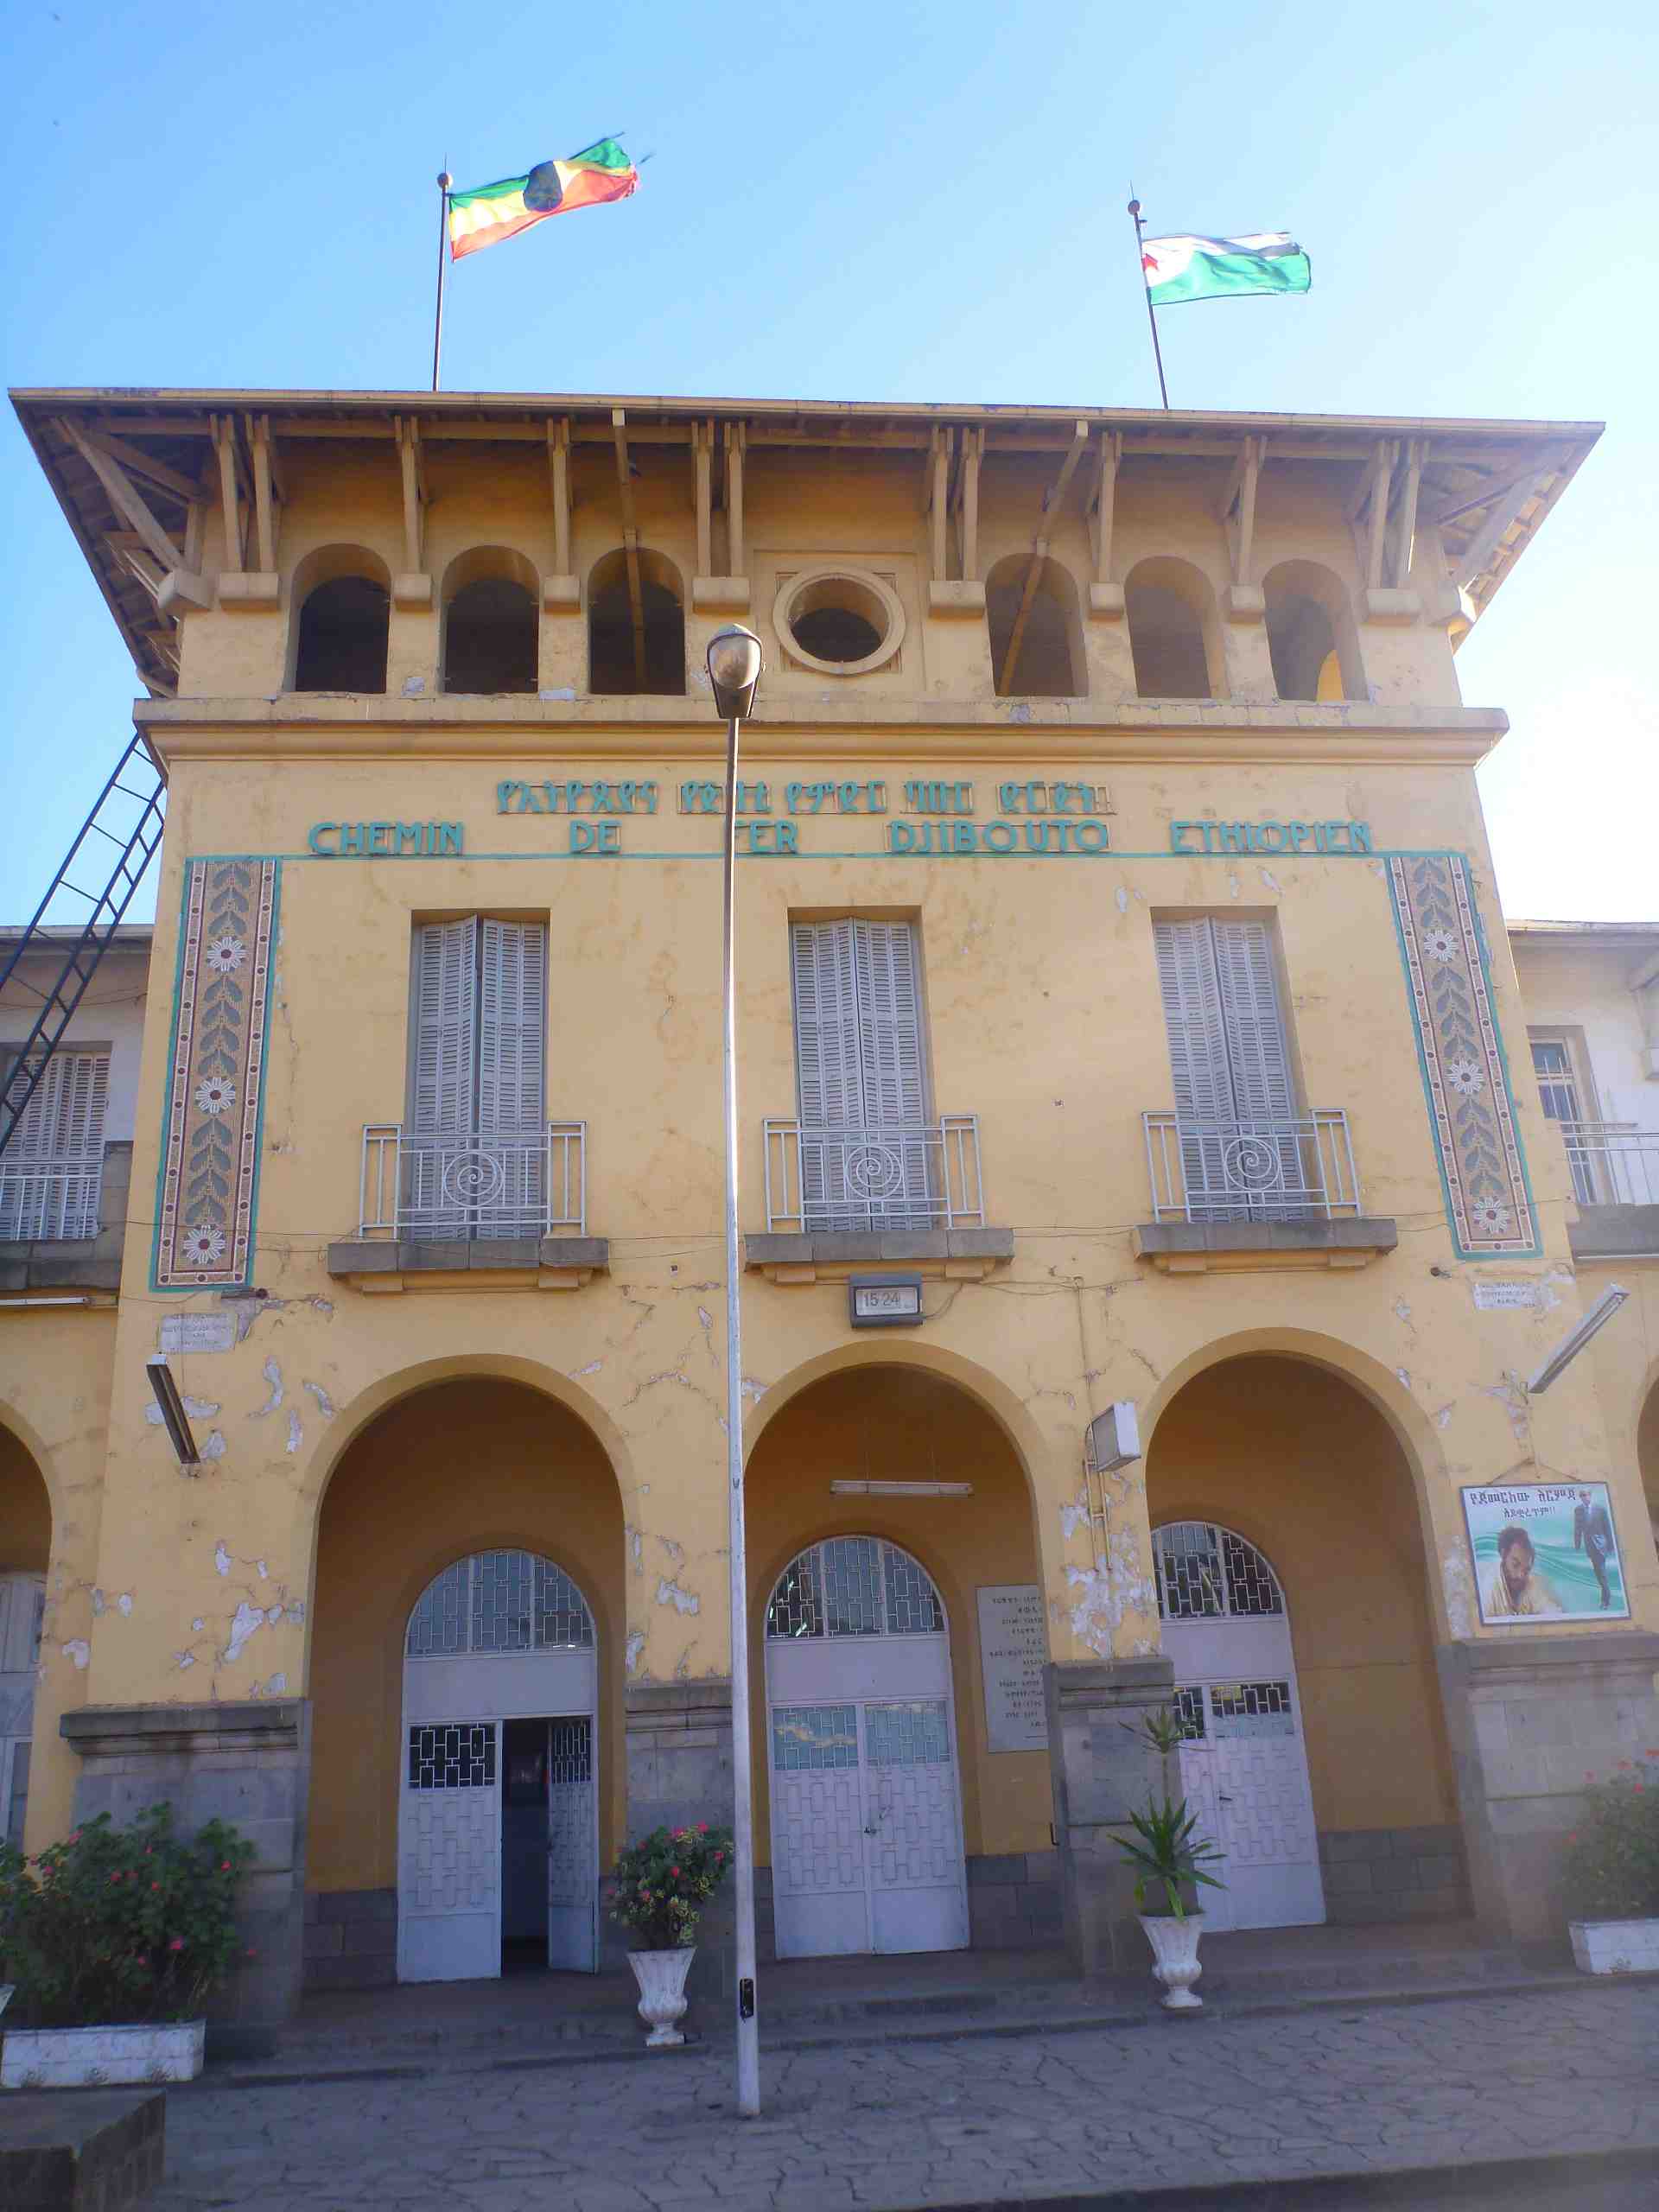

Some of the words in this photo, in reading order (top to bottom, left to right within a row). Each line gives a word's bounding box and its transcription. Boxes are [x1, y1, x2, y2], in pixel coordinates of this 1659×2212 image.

[308, 821, 463, 855] CHEMIN
[570, 819, 621, 853] DE
[891, 819, 1109, 854] DJIBOUTO
[1170, 820, 1372, 854] ETHIOPIEN
